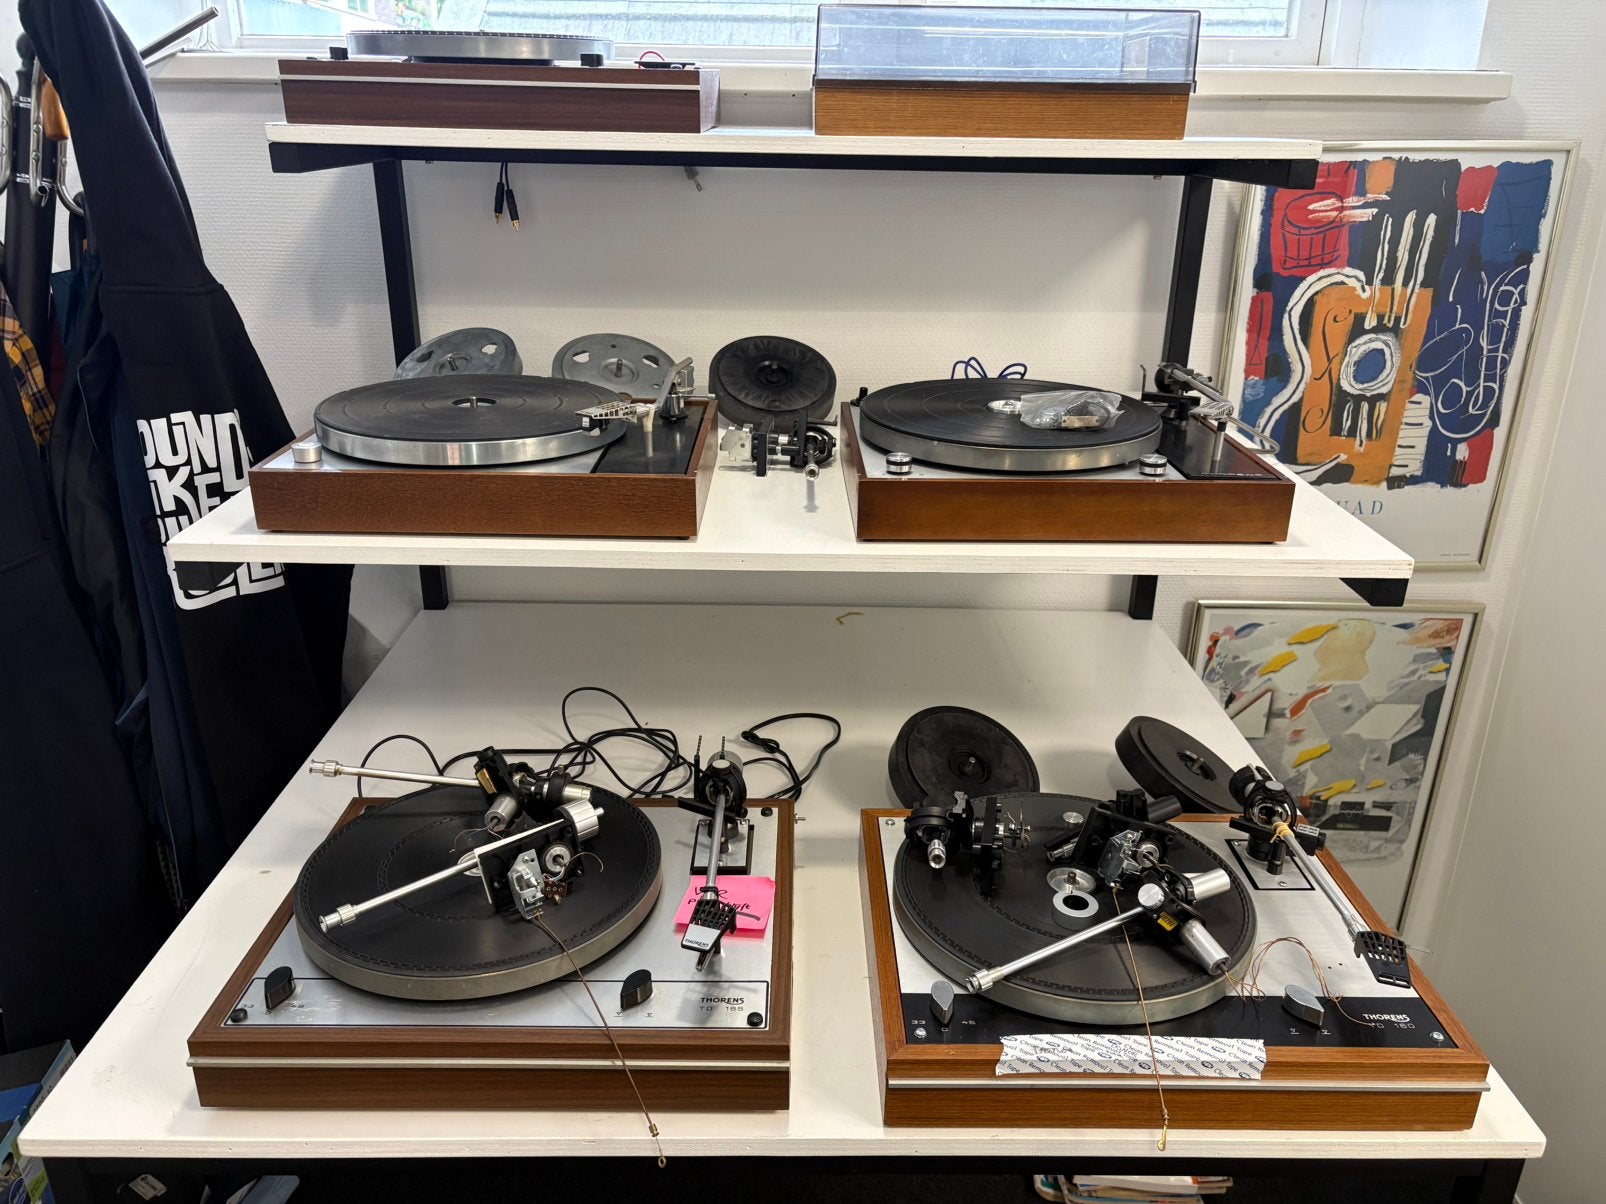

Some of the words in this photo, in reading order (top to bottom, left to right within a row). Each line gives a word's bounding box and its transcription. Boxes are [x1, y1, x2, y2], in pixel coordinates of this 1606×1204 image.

[700, 997, 744, 1005] THORENS
[1362, 1014, 1410, 1023] THORENS
[1154, 1039, 1184, 1053] Removal
[1175, 1040, 1196, 1050] Clean
